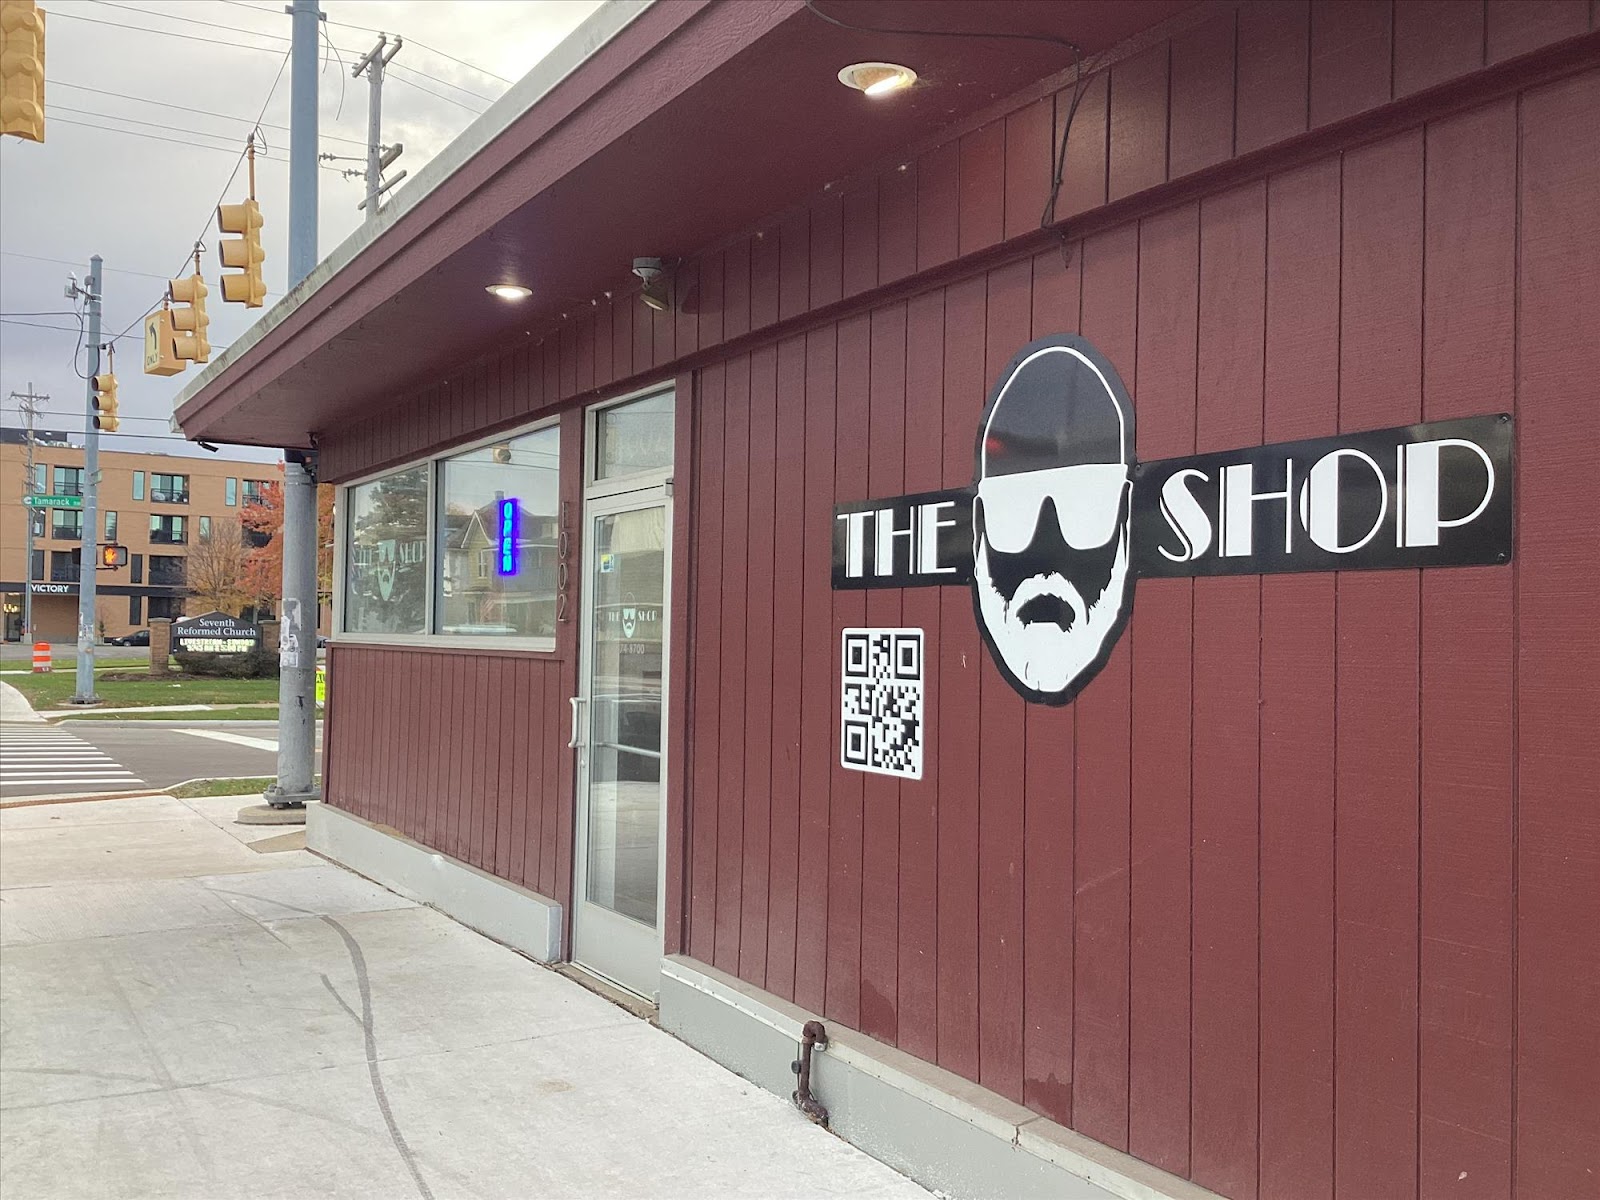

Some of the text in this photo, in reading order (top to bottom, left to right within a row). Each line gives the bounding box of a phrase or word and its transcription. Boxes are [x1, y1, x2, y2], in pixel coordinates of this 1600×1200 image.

[34, 497, 70, 505] Tamarack
[836, 438, 1495, 579] THE SHOP
[503, 501, 513, 572] OPEN
[558, 501, 568, 622] 1002
[31, 584, 69, 593] VICTORY
[199, 618, 235, 627] Seventh
[177, 627, 257, 637] Reformed Church
